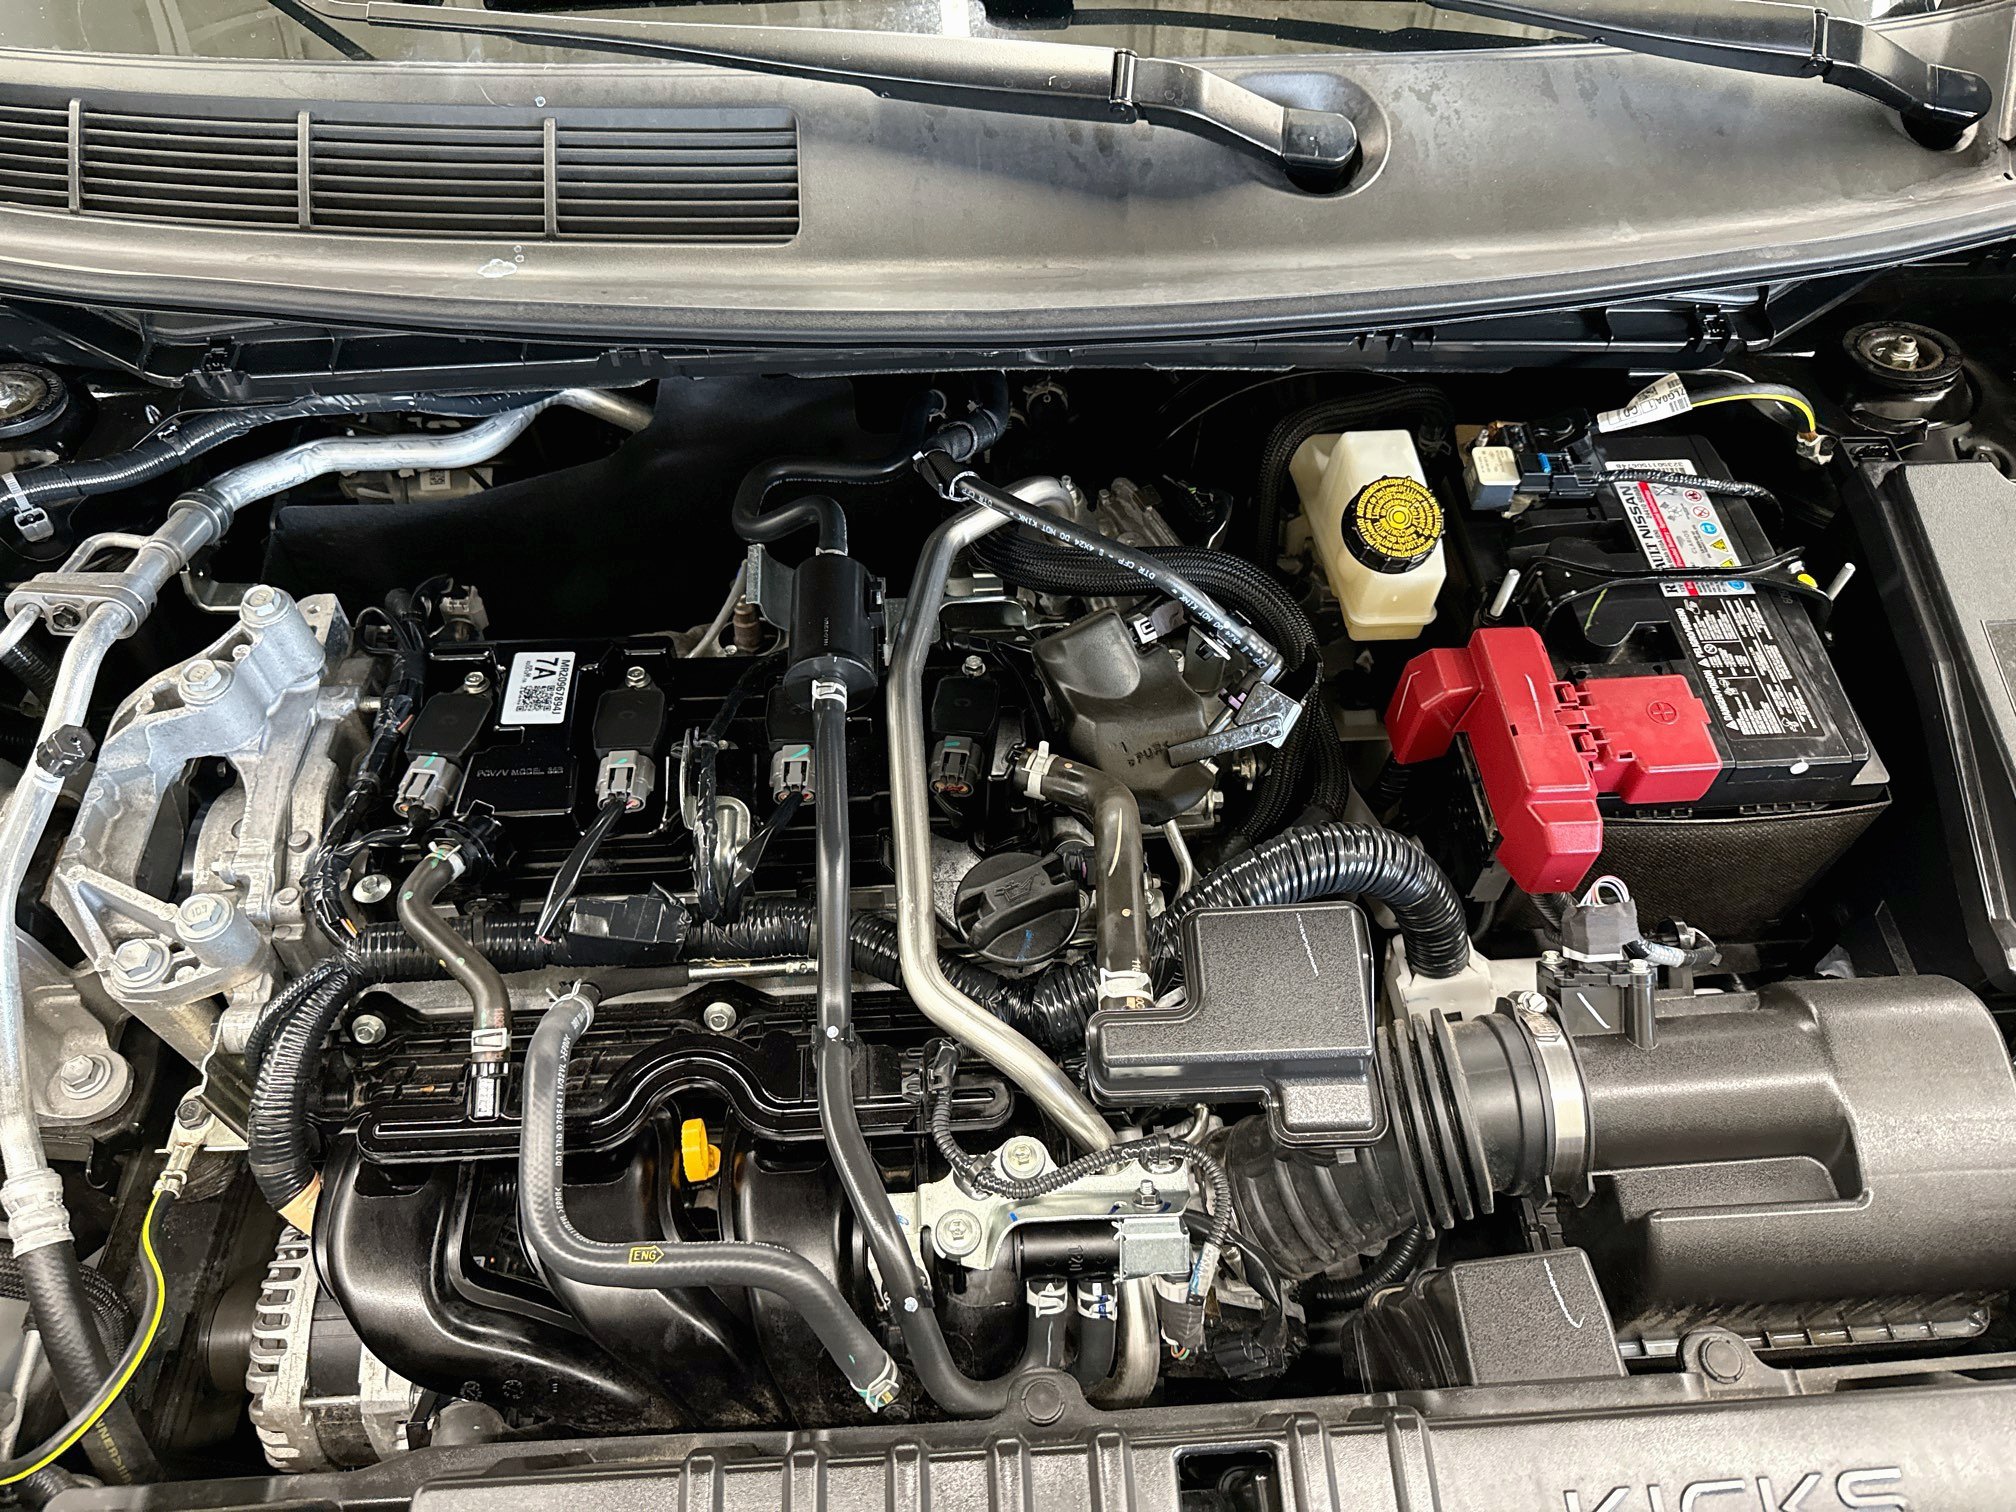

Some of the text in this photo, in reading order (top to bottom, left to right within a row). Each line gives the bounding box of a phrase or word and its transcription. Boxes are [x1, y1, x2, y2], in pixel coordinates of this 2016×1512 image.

[1041, 525, 1056, 536] NOT
[1619, 485, 1678, 592] RAULT NISSAN
[532, 657, 559, 680] 7A
[1703, 669, 1732, 720] DANGER/POISON
[633, 1250, 657, 1261] ENG
